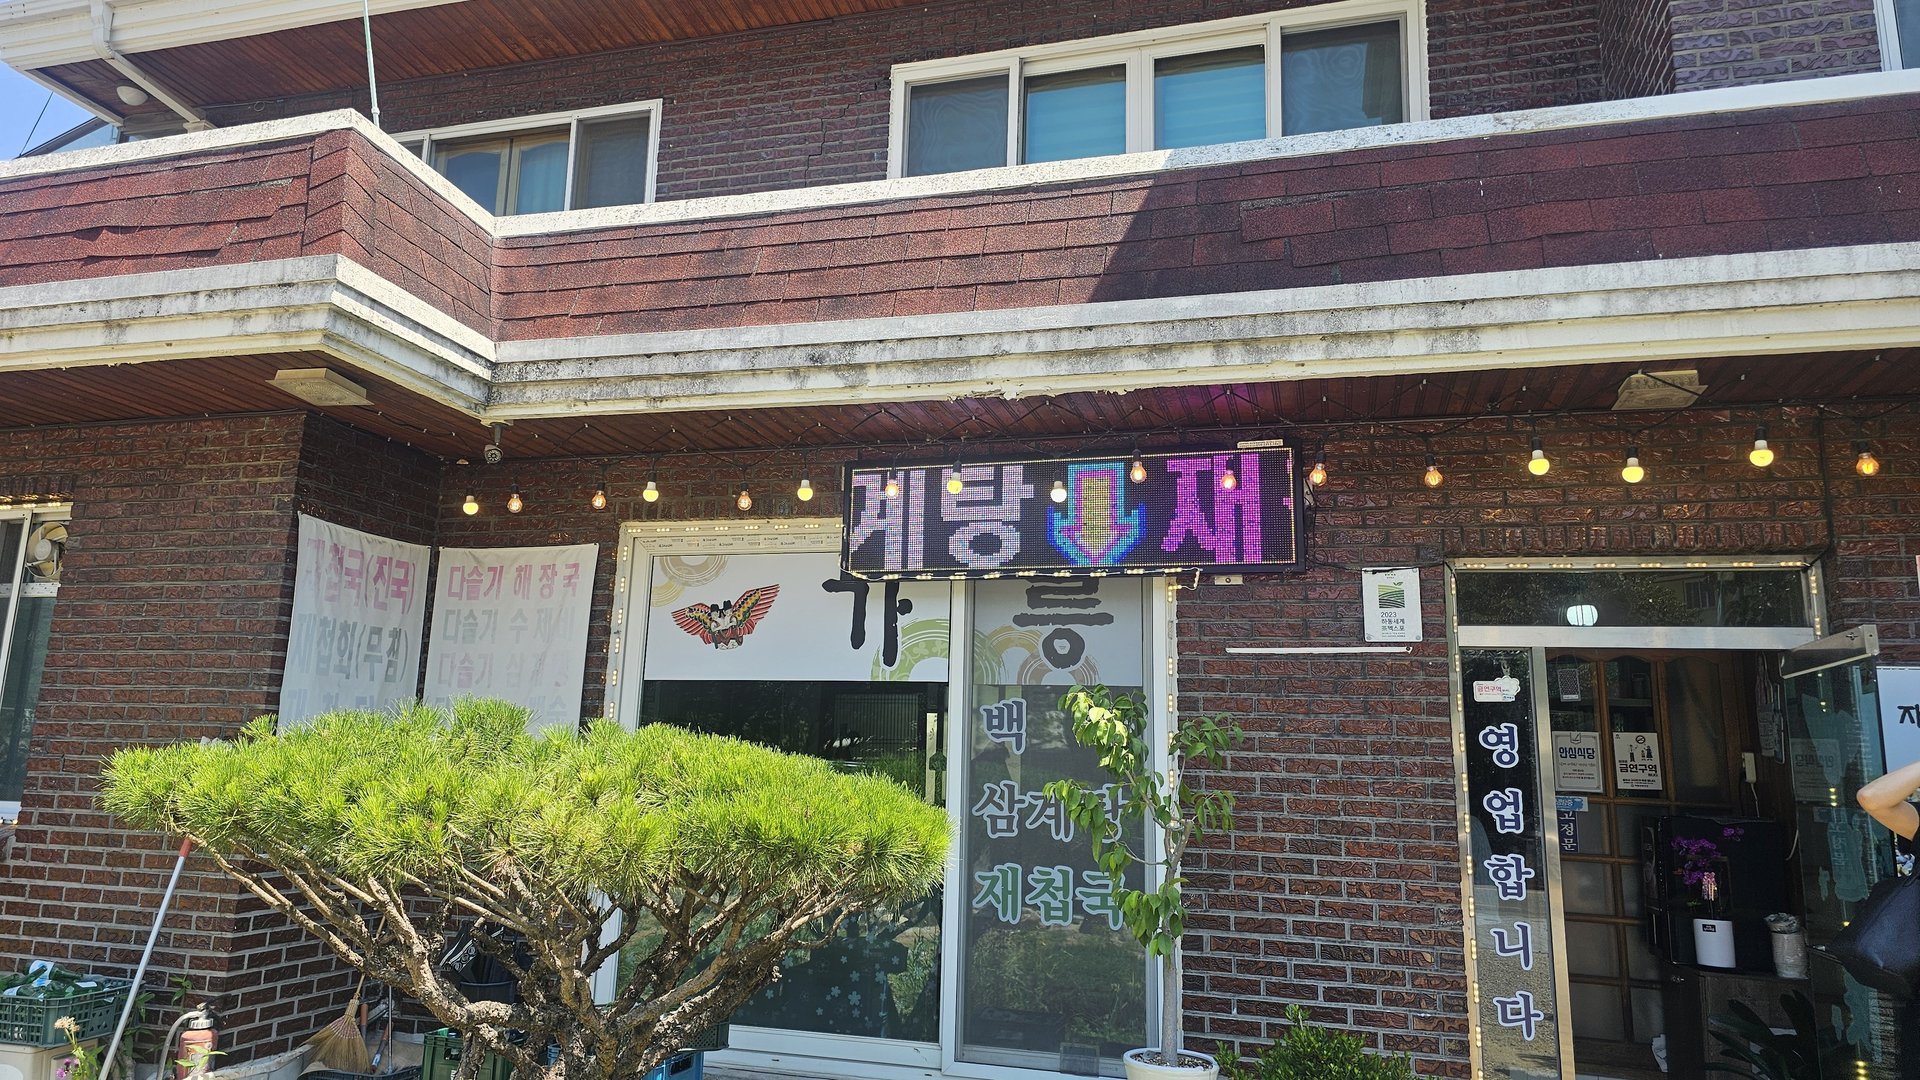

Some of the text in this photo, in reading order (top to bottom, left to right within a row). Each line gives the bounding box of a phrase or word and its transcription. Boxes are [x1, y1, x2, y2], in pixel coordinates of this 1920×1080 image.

[1161, 454, 1292, 563] 재
[447, 561, 581, 601] 다슬기 해장국
[442, 607, 499, 645] 다슬기
[437, 651, 494, 689] 다슬기
[980, 699, 1027, 755] 백
[1558, 746, 1596, 760] 안심식당
[1618, 763, 1658, 774] 금연구역
[973, 862, 1126, 931] 재첩국
[1479, 723, 1545, 1041] 영업합니다
